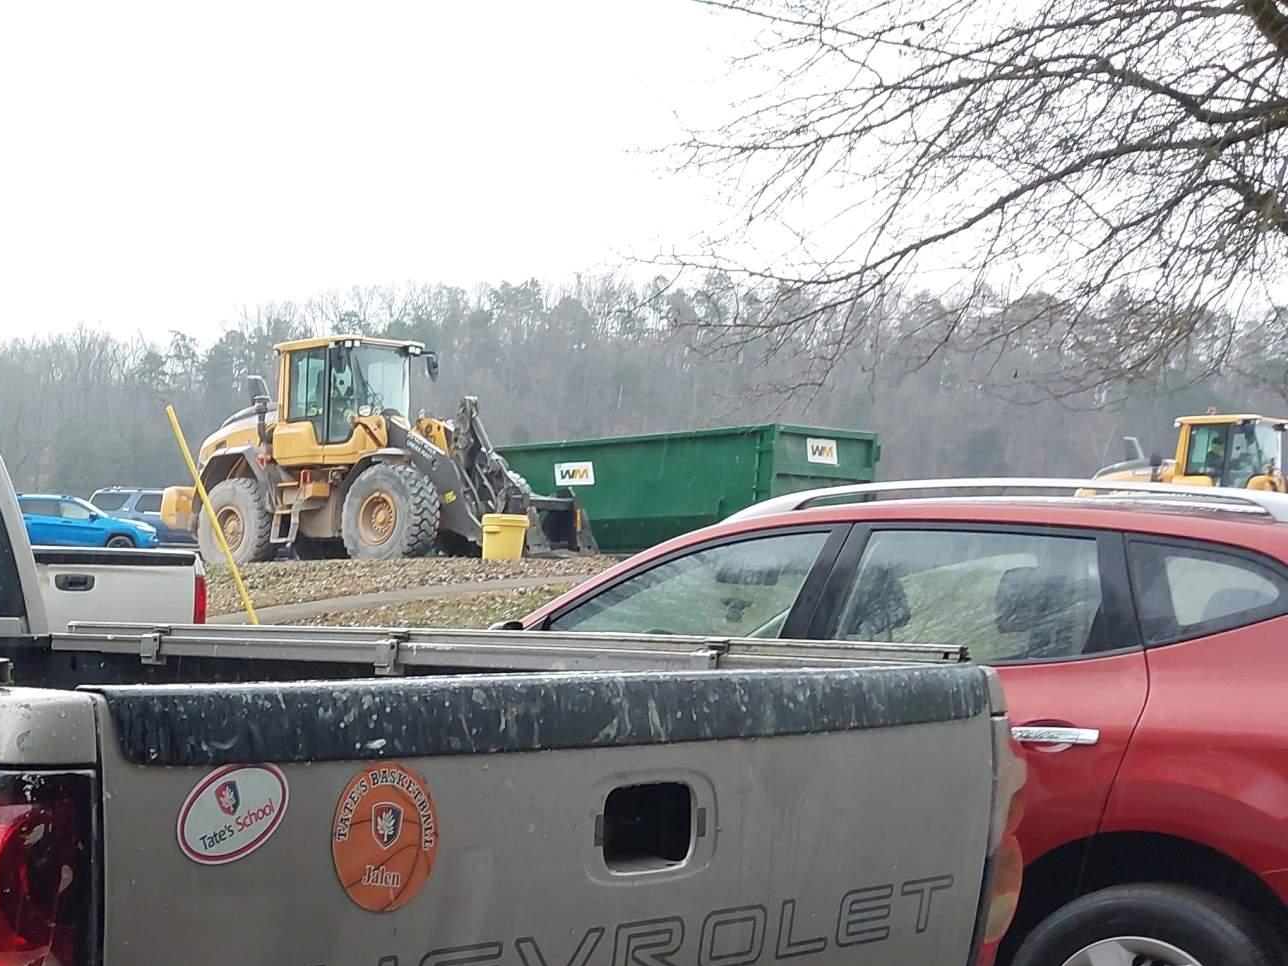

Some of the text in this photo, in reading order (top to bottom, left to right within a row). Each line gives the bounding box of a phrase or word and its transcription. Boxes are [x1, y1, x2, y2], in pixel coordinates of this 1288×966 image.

[811, 444, 832, 457] WM
[560, 469, 588, 479] WM
[370, 767, 436, 850] BASKETBALL
[199, 798, 275, 850] Tate's School
[362, 865, 401, 887] Jalen
